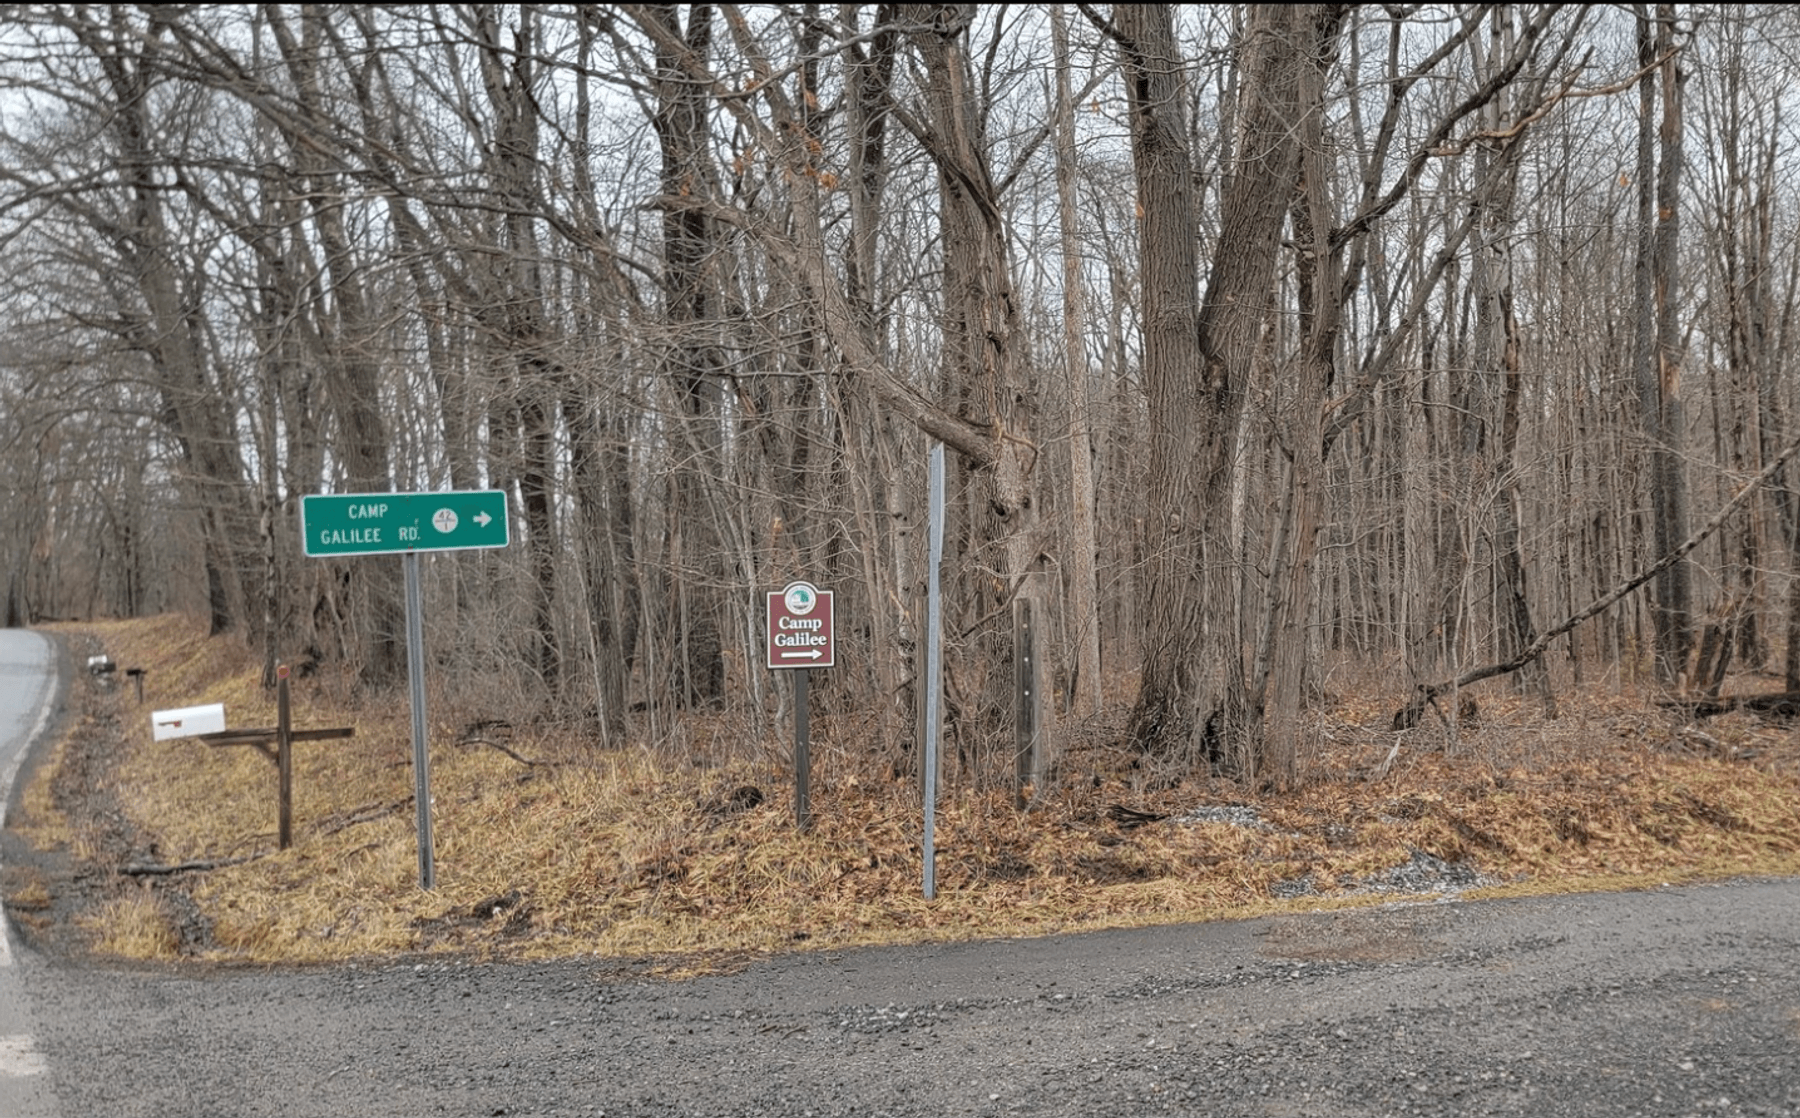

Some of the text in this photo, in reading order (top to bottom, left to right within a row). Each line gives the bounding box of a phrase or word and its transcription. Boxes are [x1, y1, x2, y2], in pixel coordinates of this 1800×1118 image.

[348, 503, 388, 519] CAMP
[320, 526, 421, 545] GALILEE RD.
[778, 616, 822, 632] Camp
[774, 632, 827, 647] Galilee
